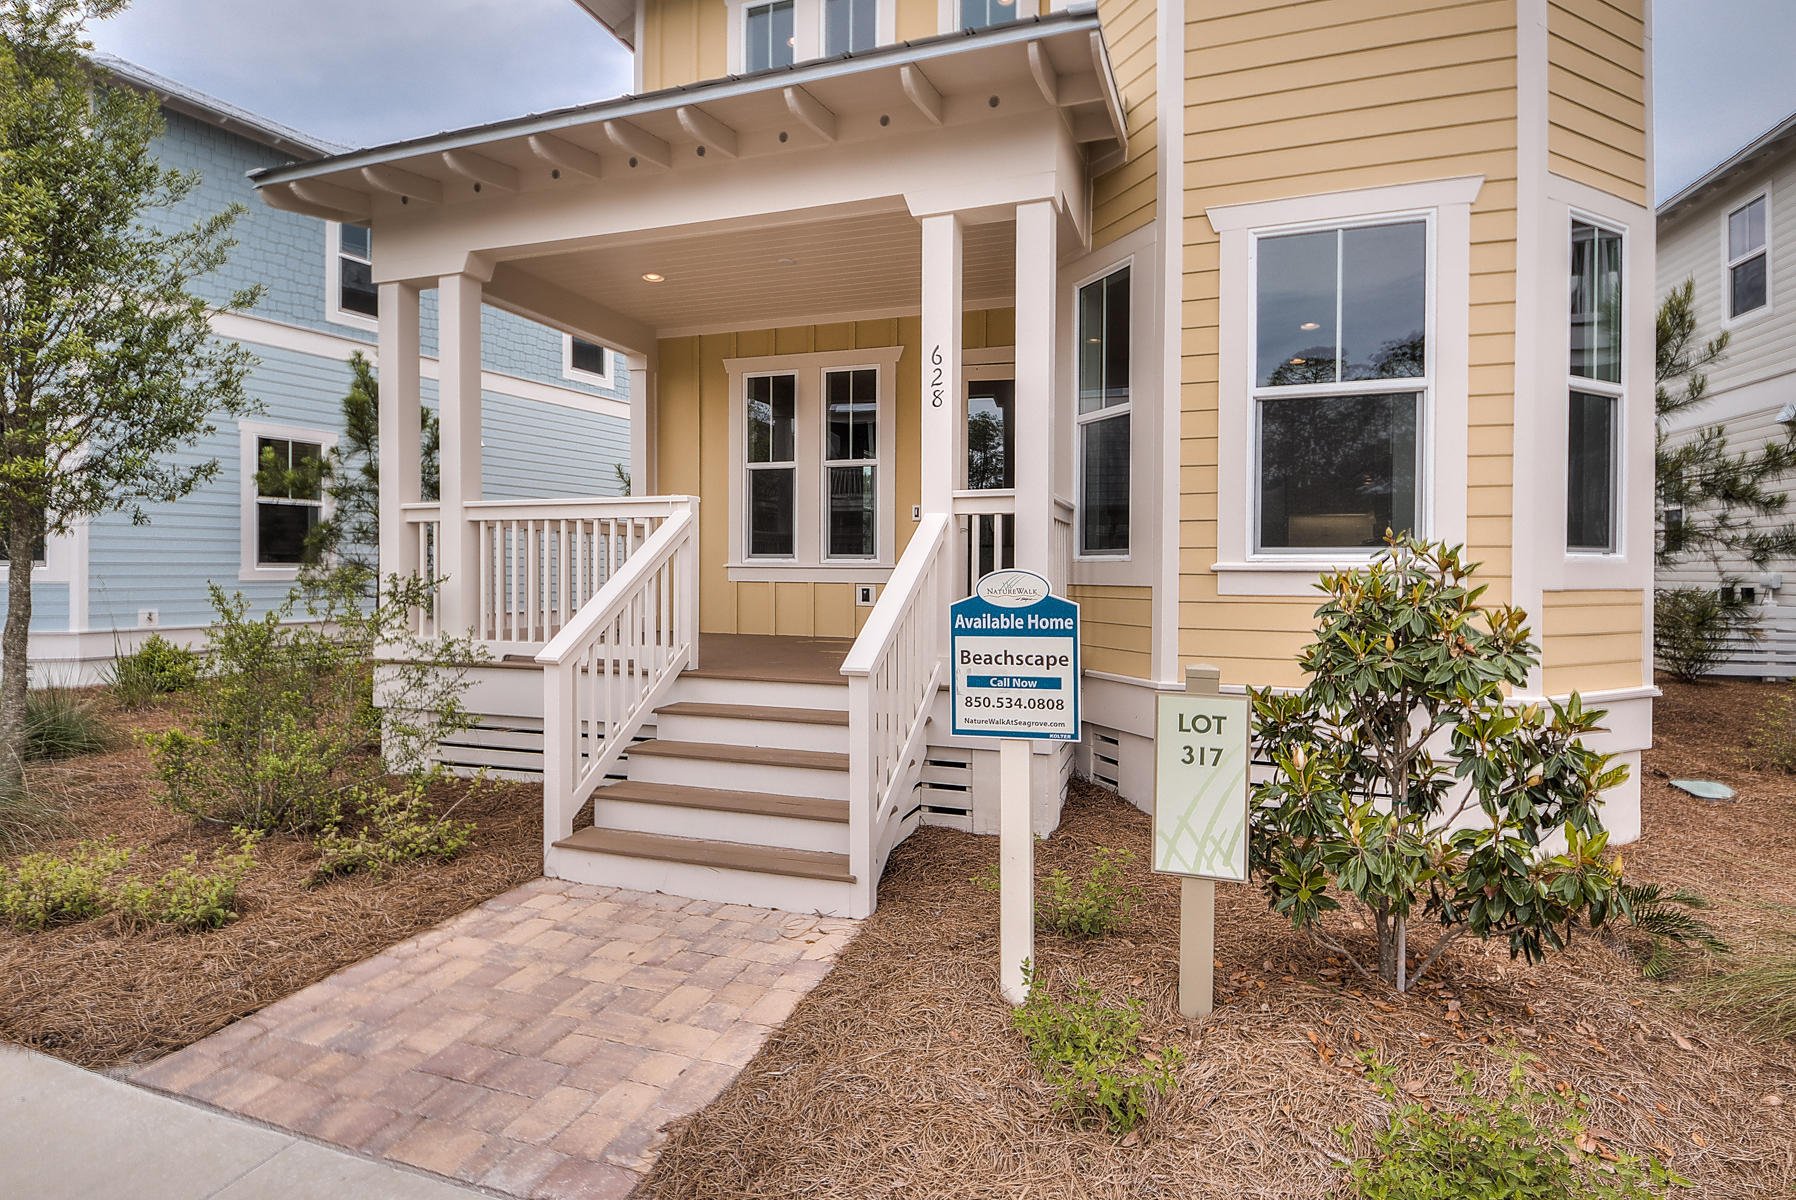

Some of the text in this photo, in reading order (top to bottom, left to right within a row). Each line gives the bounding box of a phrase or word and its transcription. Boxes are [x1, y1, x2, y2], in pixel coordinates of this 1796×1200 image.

[931, 344, 945, 408] 628
[954, 613, 1074, 630] Available Home
[960, 649, 1070, 670] Beachscape
[989, 677, 1038, 688] Call Now
[964, 696, 1065, 711] 850.534.0808
[964, 717, 1066, 729] NatureWalkAtSeagrove.com
[1178, 713, 1227, 734] LOT
[1181, 745, 1224, 767] 317
